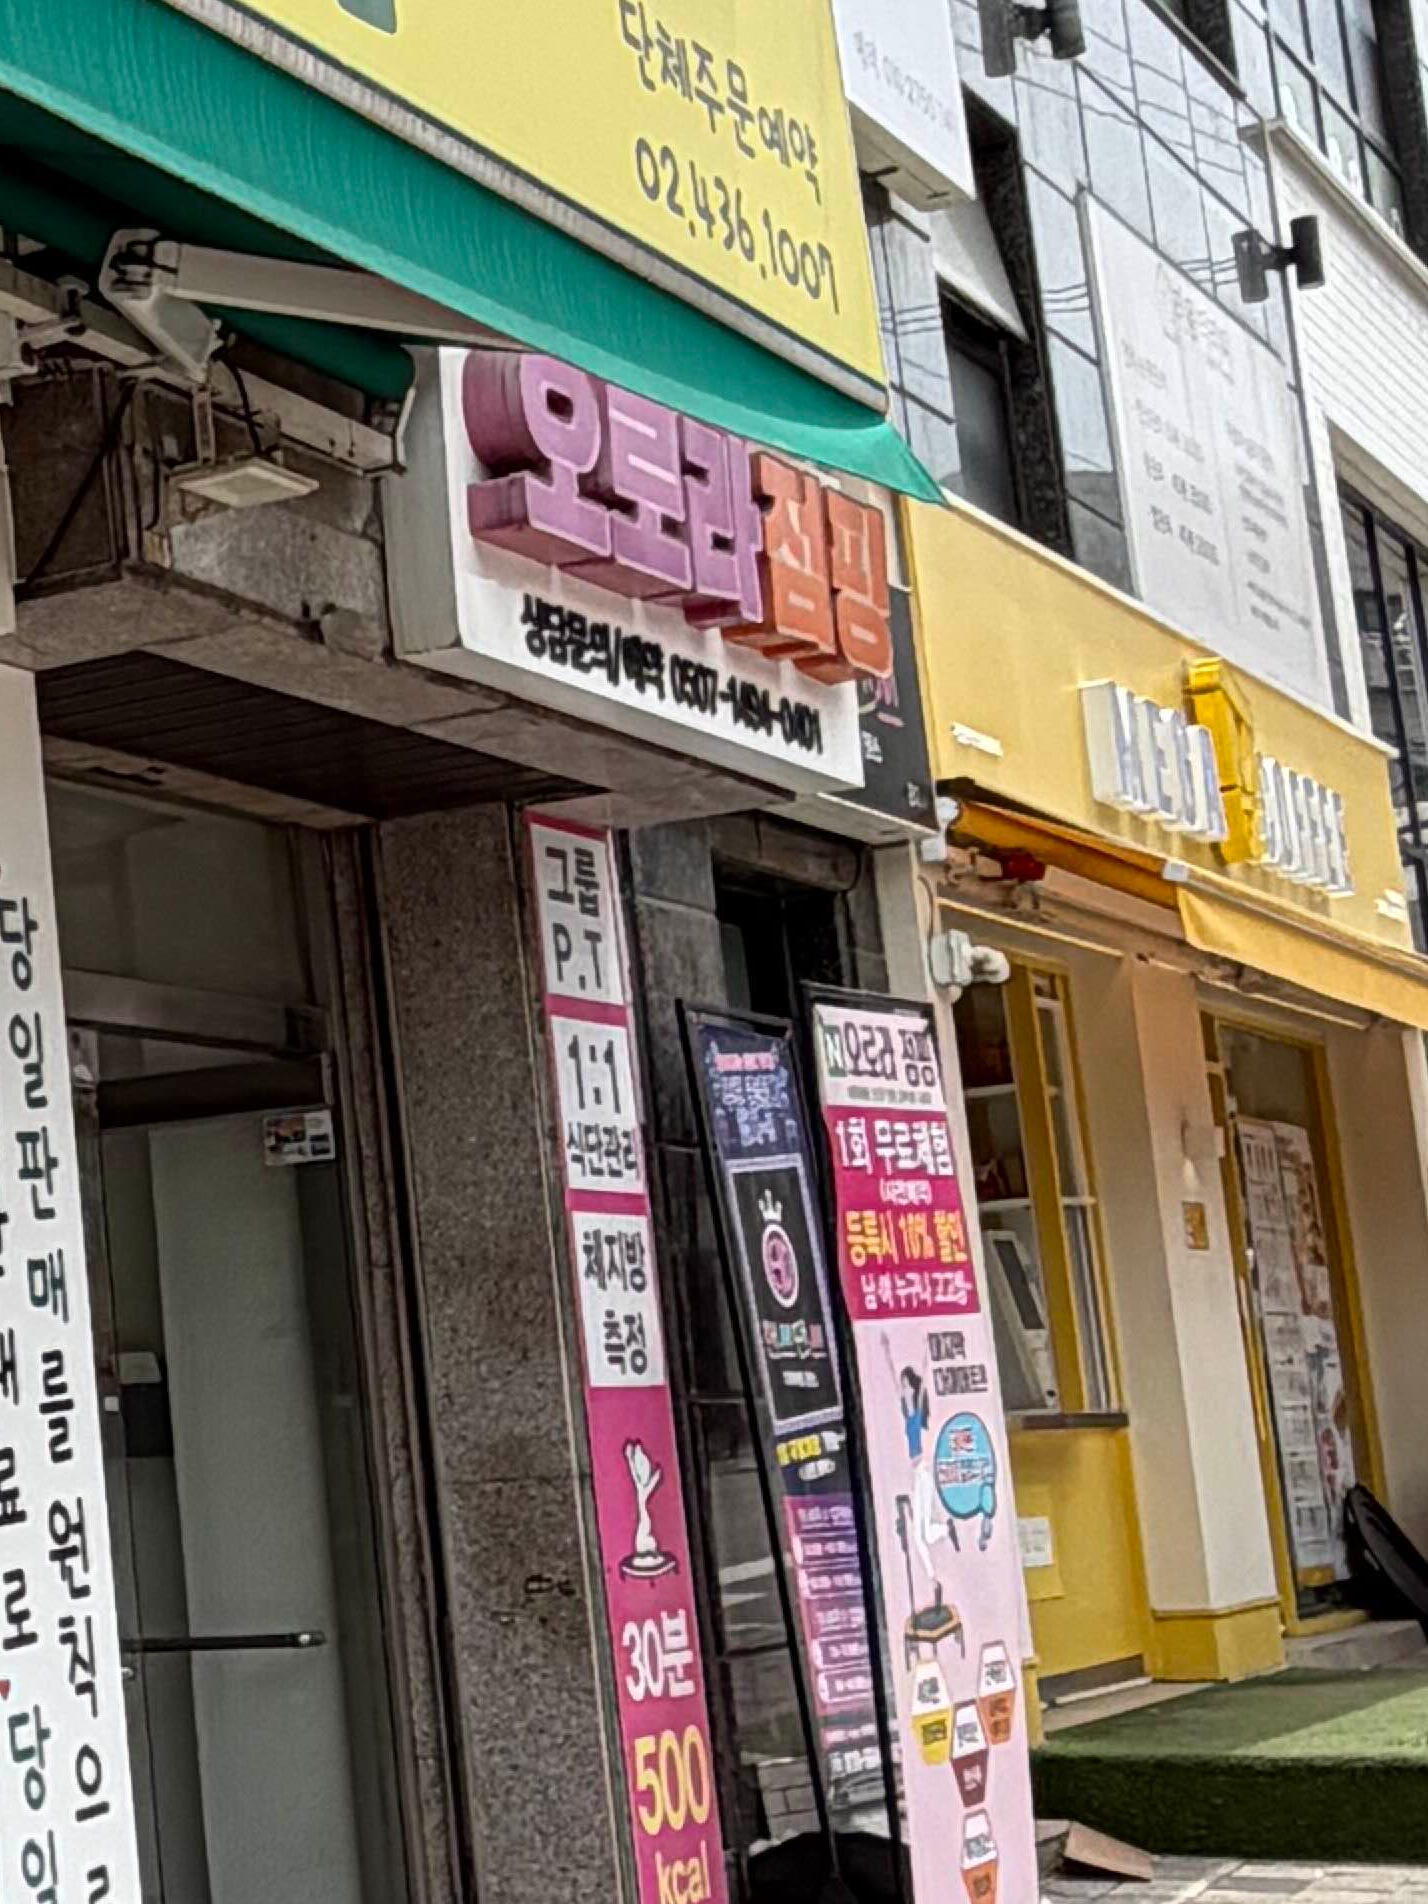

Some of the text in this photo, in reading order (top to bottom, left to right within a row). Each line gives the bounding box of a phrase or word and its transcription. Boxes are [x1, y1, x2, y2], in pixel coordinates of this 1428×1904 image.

[635, 137, 839, 314] 02.436.1007
[544, 847, 602, 918] 그룹
[568, 1034, 622, 1114] 1:1
[583, 1229, 647, 1293] 체지방
[602, 1310, 648, 1375] 측정
[623, 1608, 696, 1702] 30분
[634, 1724, 711, 1836] 500
